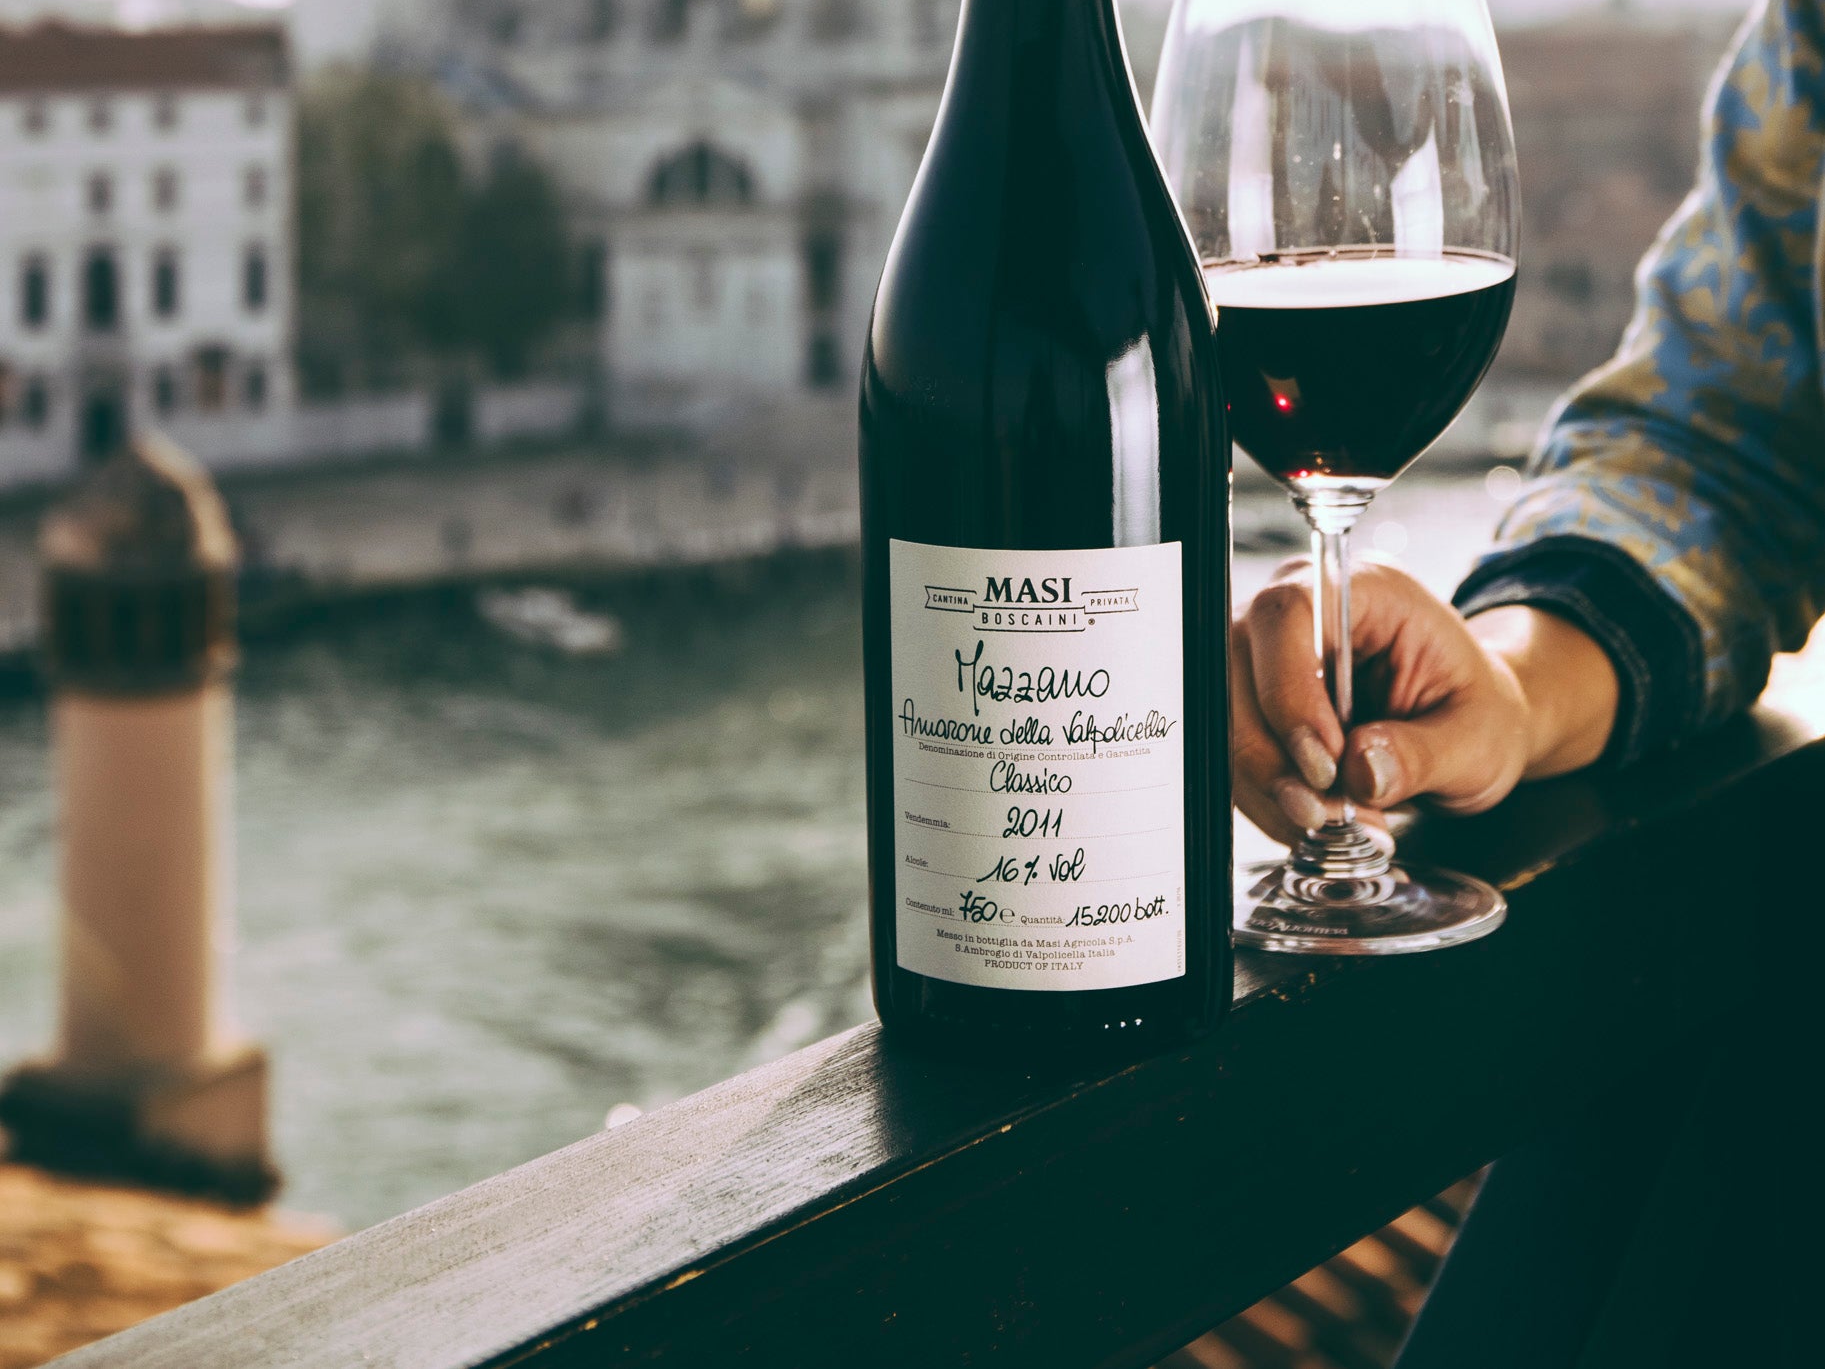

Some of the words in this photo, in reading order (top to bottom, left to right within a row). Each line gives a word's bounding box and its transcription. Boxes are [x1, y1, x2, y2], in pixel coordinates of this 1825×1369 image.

[932, 593, 969, 606] CANTINA
[983, 576, 1072, 604] MASI
[1090, 596, 1130, 607] PRIVATA
[981, 612, 1077, 626] BOSCAINI
[955, 639, 1110, 717] Mazzano
[898, 698, 994, 745] Amarone
[1000, 716, 1054, 746] della
[918, 741, 985, 759] Denominazione
[986, 750, 996, 760] di
[998, 751, 1035, 763] Origine
[1037, 750, 1096, 762] Controllata
[1106, 746, 1151, 759] Garantita
[989, 760, 1073, 794] Classico
[904, 810, 951, 829] Vendemmia:
[1003, 806, 1063, 839] 2011
[905, 897, 941, 914] Contenuto
[958, 890, 998, 923] 750
[936, 928, 963, 942] Messo
[964, 933, 974, 943] in
[976, 935, 1019, 948] bottiglia
[1020, 939, 1033, 948] da
[1036, 939, 1061, 948] Masi
[1063, 938, 1107, 950] Agricola
[984, 959, 1033, 971] PRODUCT
[1034, 961, 1049, 971] OF
[1051, 961, 1084, 971] ITALY
[1012, 949, 1023, 959] di
[1026, 950, 1086, 960] Valpolicella
[1088, 948, 1116, 958] Italia
